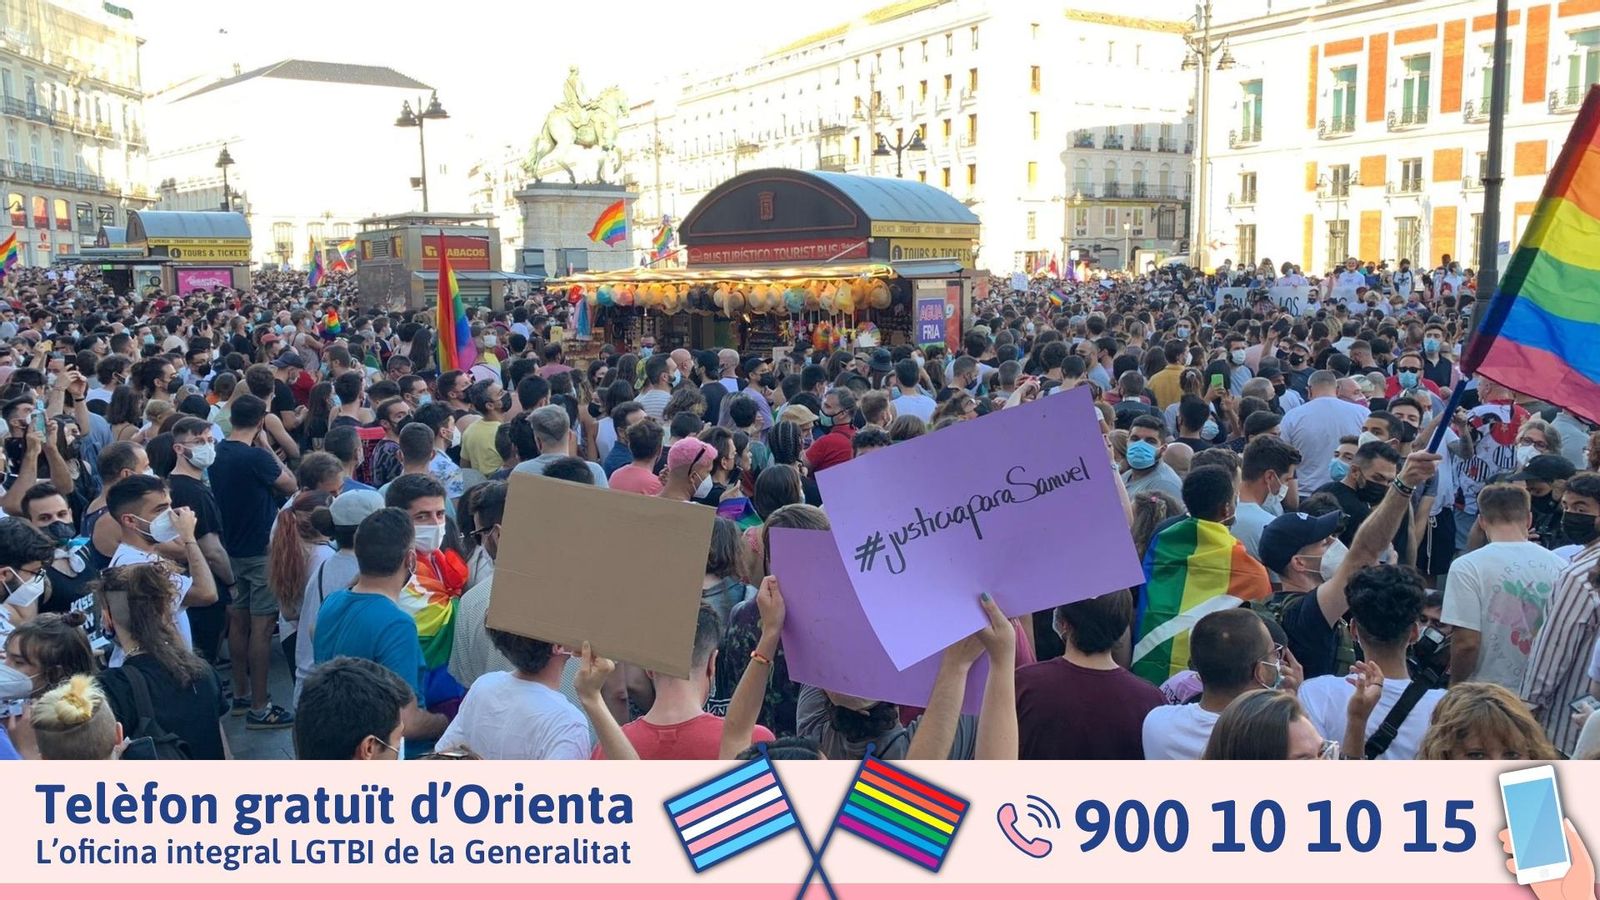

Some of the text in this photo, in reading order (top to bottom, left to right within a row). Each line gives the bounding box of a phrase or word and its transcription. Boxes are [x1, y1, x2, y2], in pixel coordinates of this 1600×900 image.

[183, 249, 207, 257] TOURS
[217, 249, 248, 257] TICKETS
[445, 248, 486, 257] ABACOS
[703, 252, 721, 262] BUS
[773, 245, 816, 260] TOURIST
[816, 243, 838, 257] BUS
[903, 247, 971, 262] TOURS & TICKETS
[920, 304, 944, 321] AGUA
[922, 324, 940, 340] FRIA
[70, 592, 94, 612] KISS
